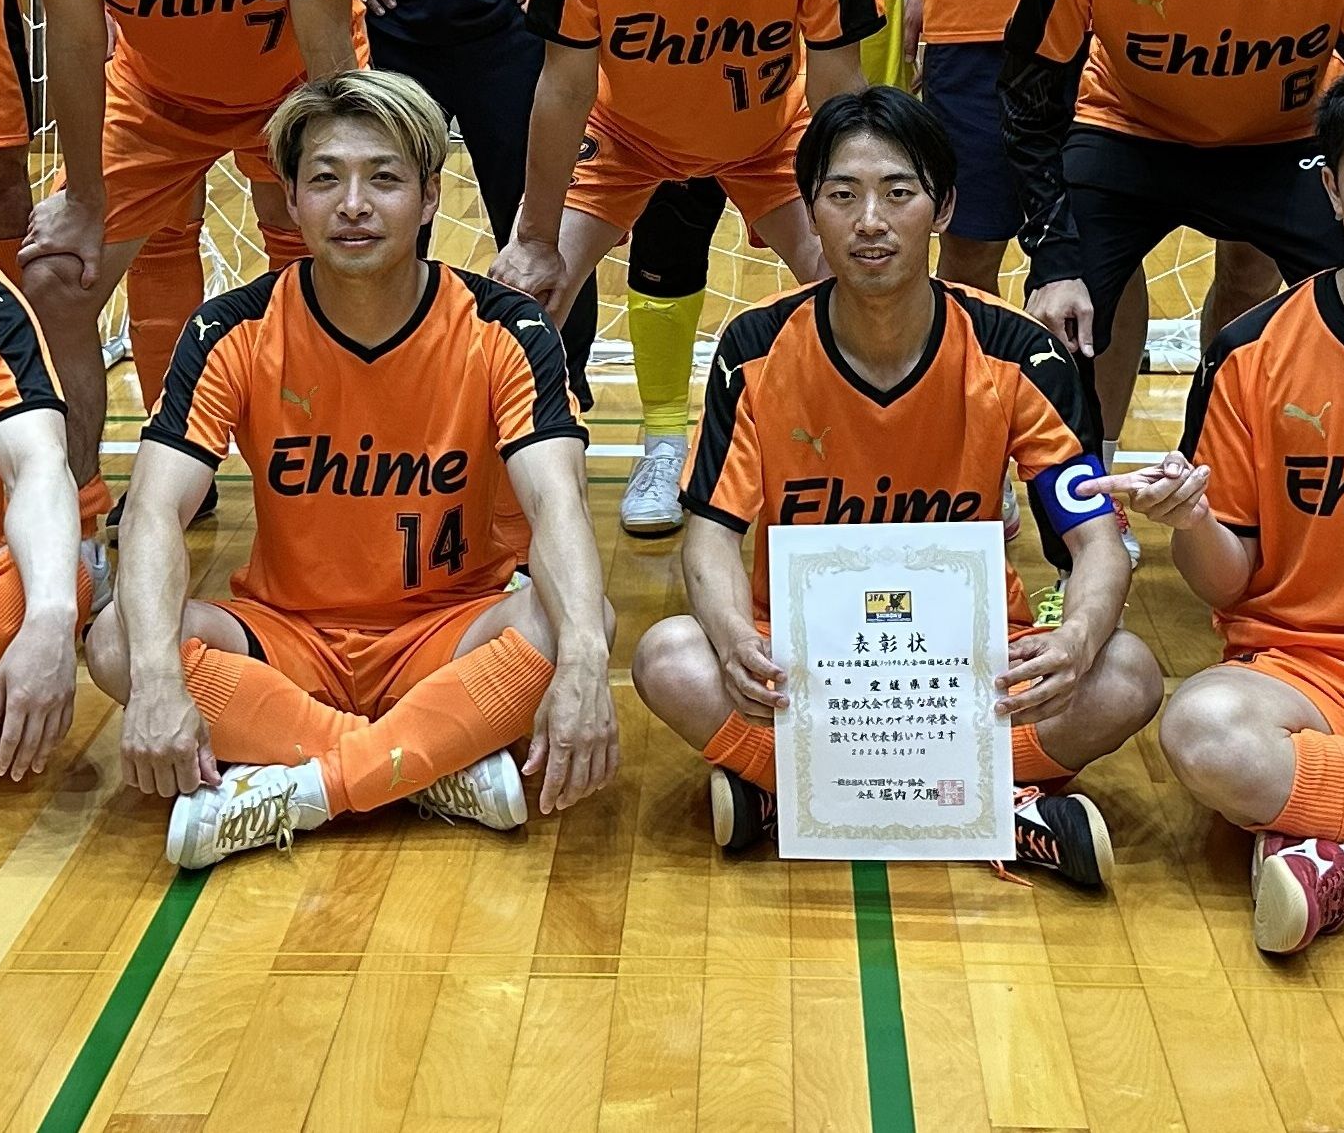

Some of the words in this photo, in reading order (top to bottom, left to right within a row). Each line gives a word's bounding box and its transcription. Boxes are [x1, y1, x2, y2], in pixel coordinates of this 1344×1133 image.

[245, 8, 288, 55] 7
[610, 13, 794, 65] Ehime
[1126, 24, 1331, 77] Ehime
[723, 53, 796, 113] 12
[268, 434, 469, 497] Ehime
[1055, 464, 1106, 514] C
[779, 475, 981, 526] Ehime
[396, 504, 469, 590] 14
[867, 593, 885, 602] JFA
[852, 632, 927, 654] 表彰状
